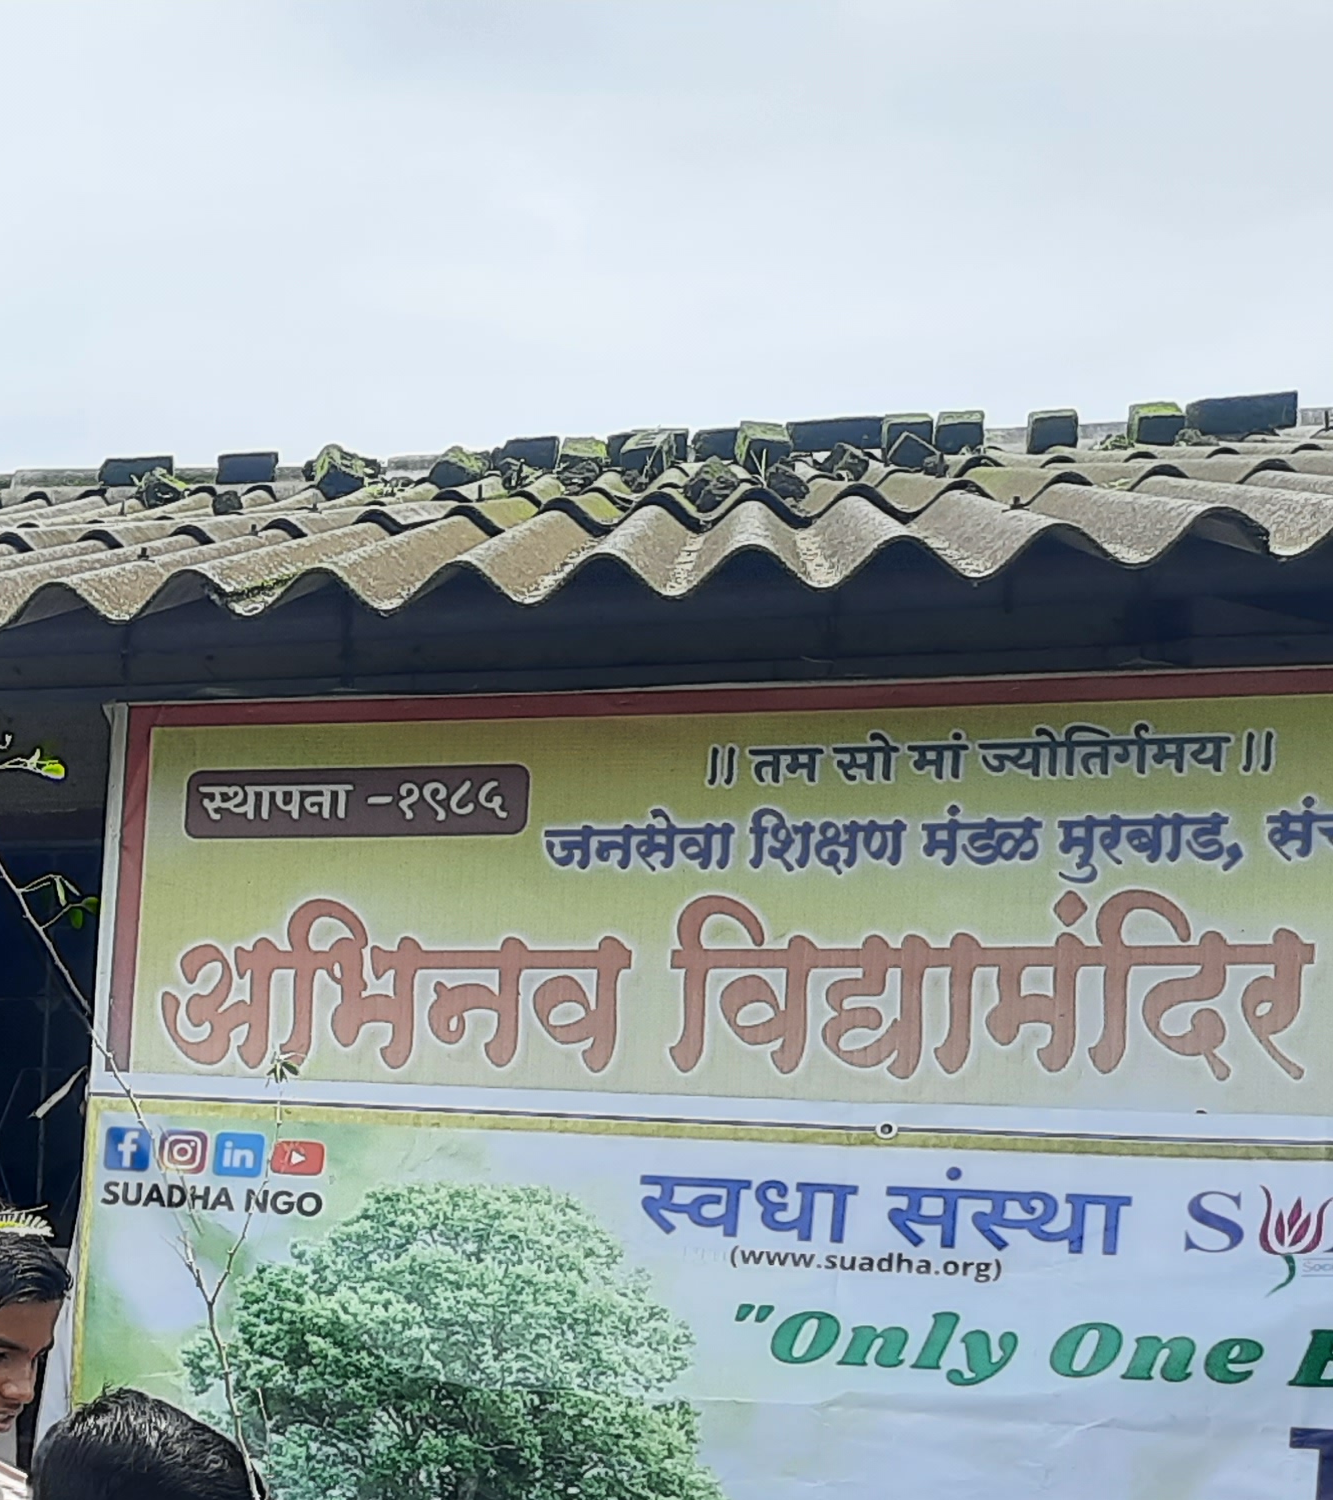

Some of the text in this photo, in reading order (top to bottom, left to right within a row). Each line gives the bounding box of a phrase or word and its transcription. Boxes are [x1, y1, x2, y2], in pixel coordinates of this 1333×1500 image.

[748, 746, 824, 785] तम
[833, 732, 900, 782] सो
[907, 732, 968, 780] मां
[979, 722, 1231, 778] ज्योतिर्गमय
[198, 783, 354, 821] स्थापना
[544, 807, 736, 872] जनसेवा
[748, 807, 907, 875] शिक्षण
[921, 803, 1043, 867] मंडळ
[1057, 811, 1244, 884] मुरबाड,
[162, 888, 1316, 1081] अभिनव विद्यामंदिर
[101, 1181, 323, 1218] SUADHA NGO
[639, 1166, 1133, 1256] स्वधा संस्था
[729, 1244, 1003, 1284] (www.suadha.org)
[1048, 1320, 1265, 1385] One
